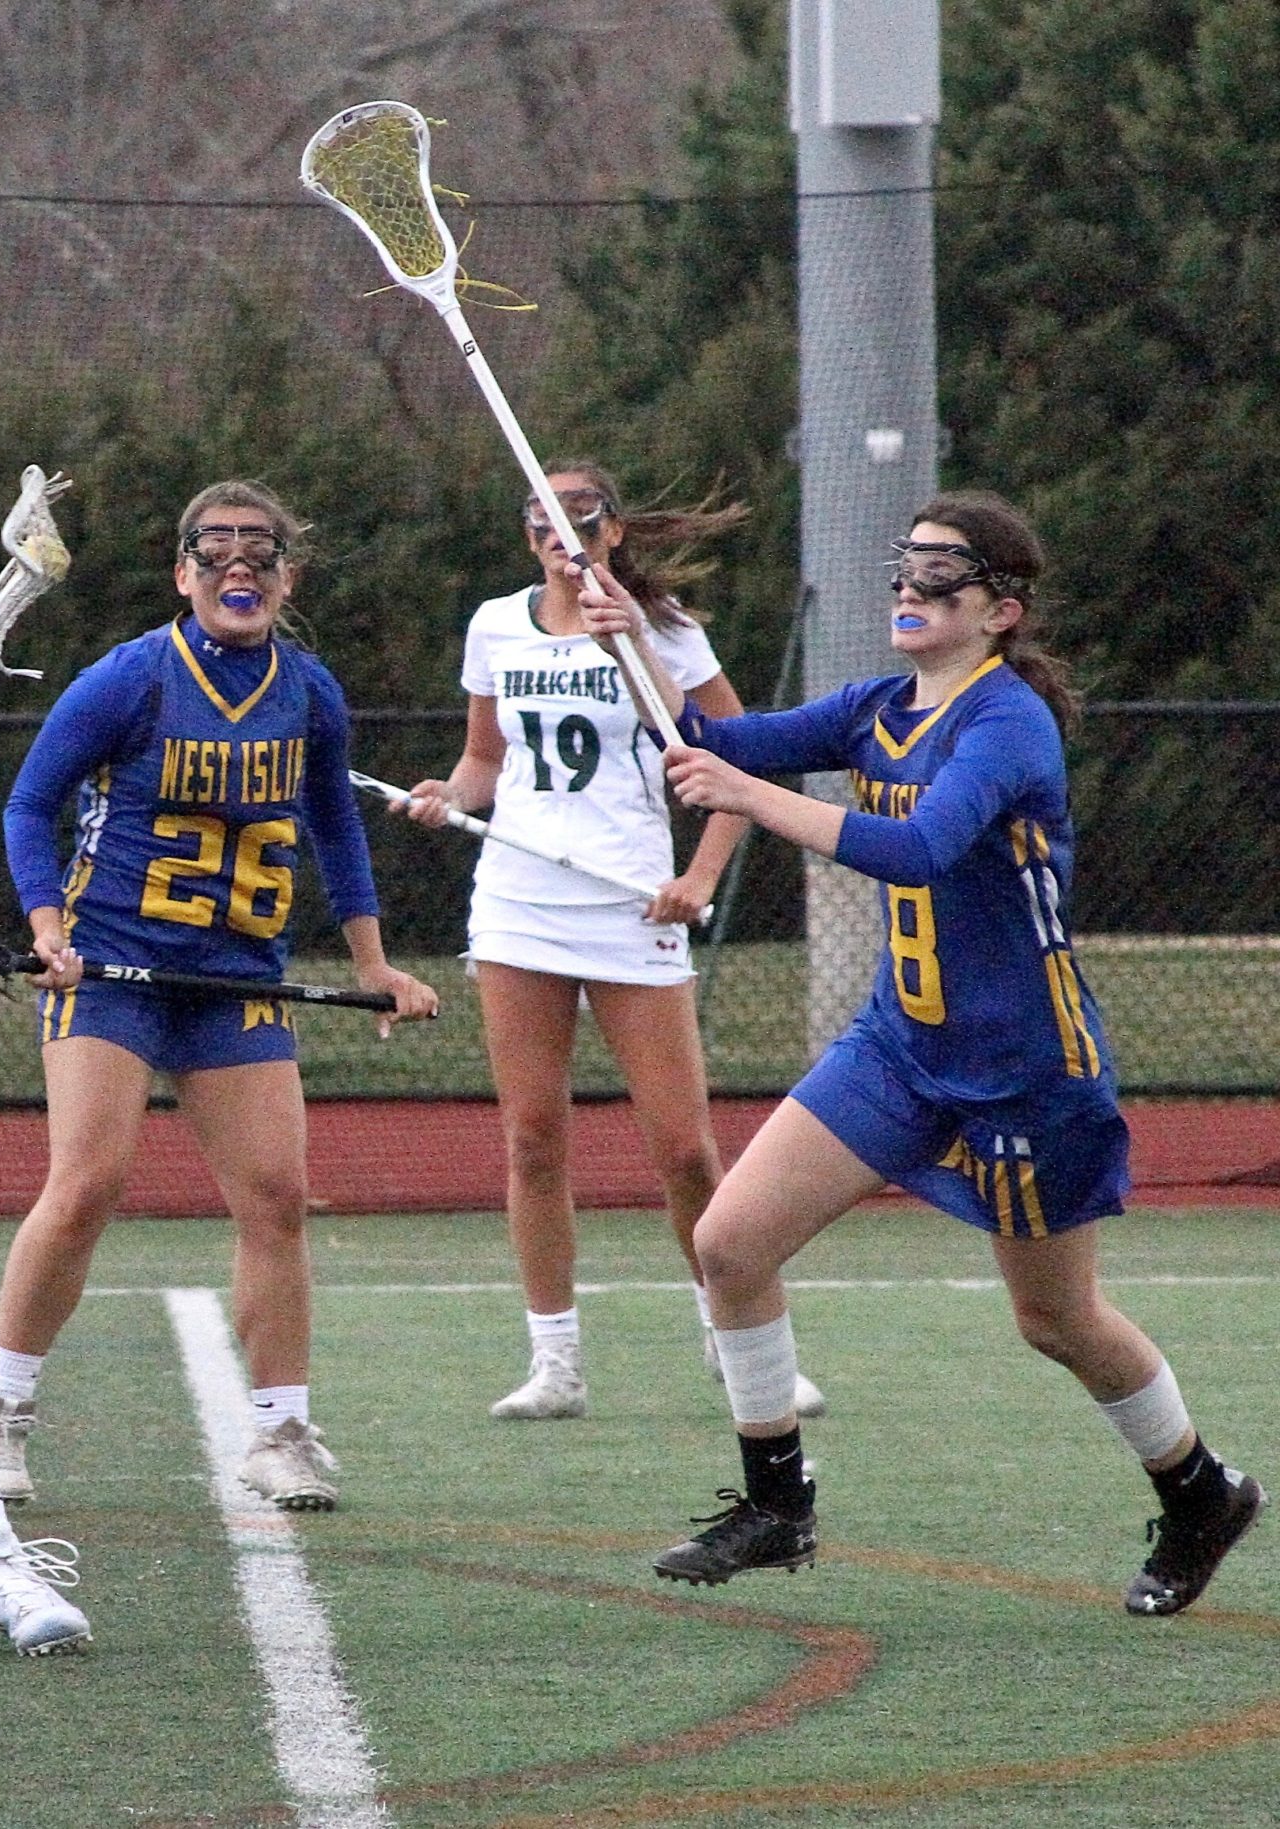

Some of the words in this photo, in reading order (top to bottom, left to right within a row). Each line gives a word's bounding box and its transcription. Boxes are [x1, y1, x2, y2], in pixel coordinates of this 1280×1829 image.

[505, 666, 619, 704] HURRICANES
[159, 738, 231, 803] WEST
[517, 711, 601, 792] 19
[140, 814, 297, 939] 26
[101, 964, 152, 982] STX
[887, 885, 946, 1026] 8
